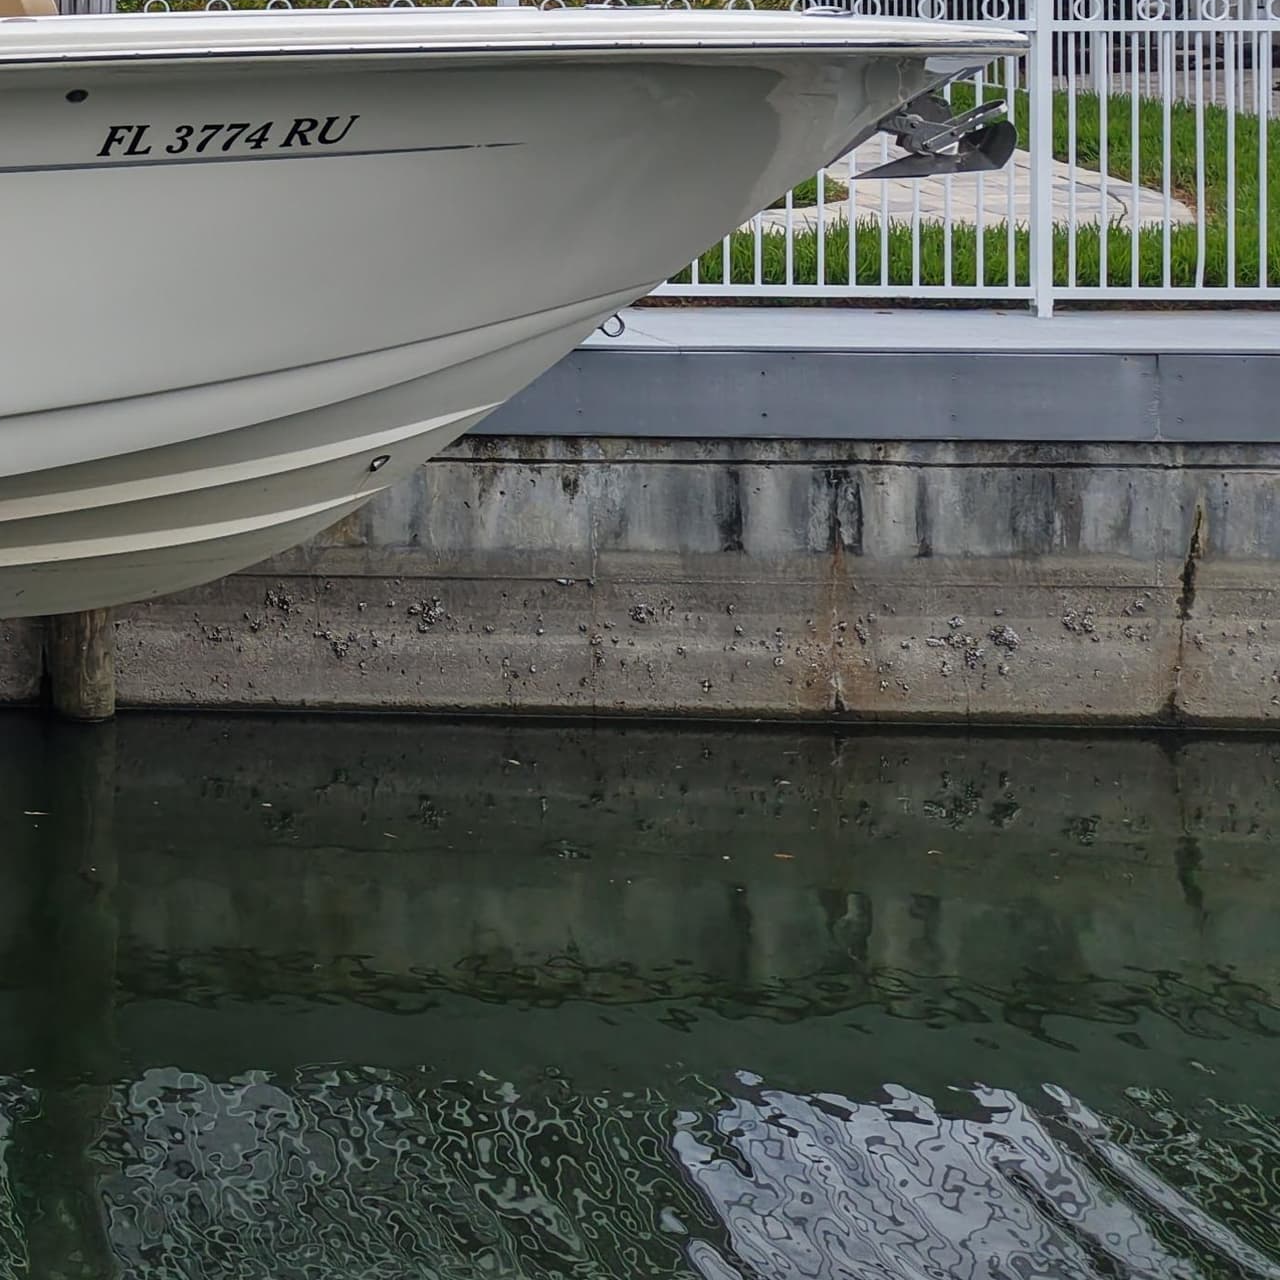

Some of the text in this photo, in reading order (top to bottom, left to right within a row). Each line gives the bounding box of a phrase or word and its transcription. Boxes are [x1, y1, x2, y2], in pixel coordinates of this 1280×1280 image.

[96, 115, 361, 157] FL 3774 RU
